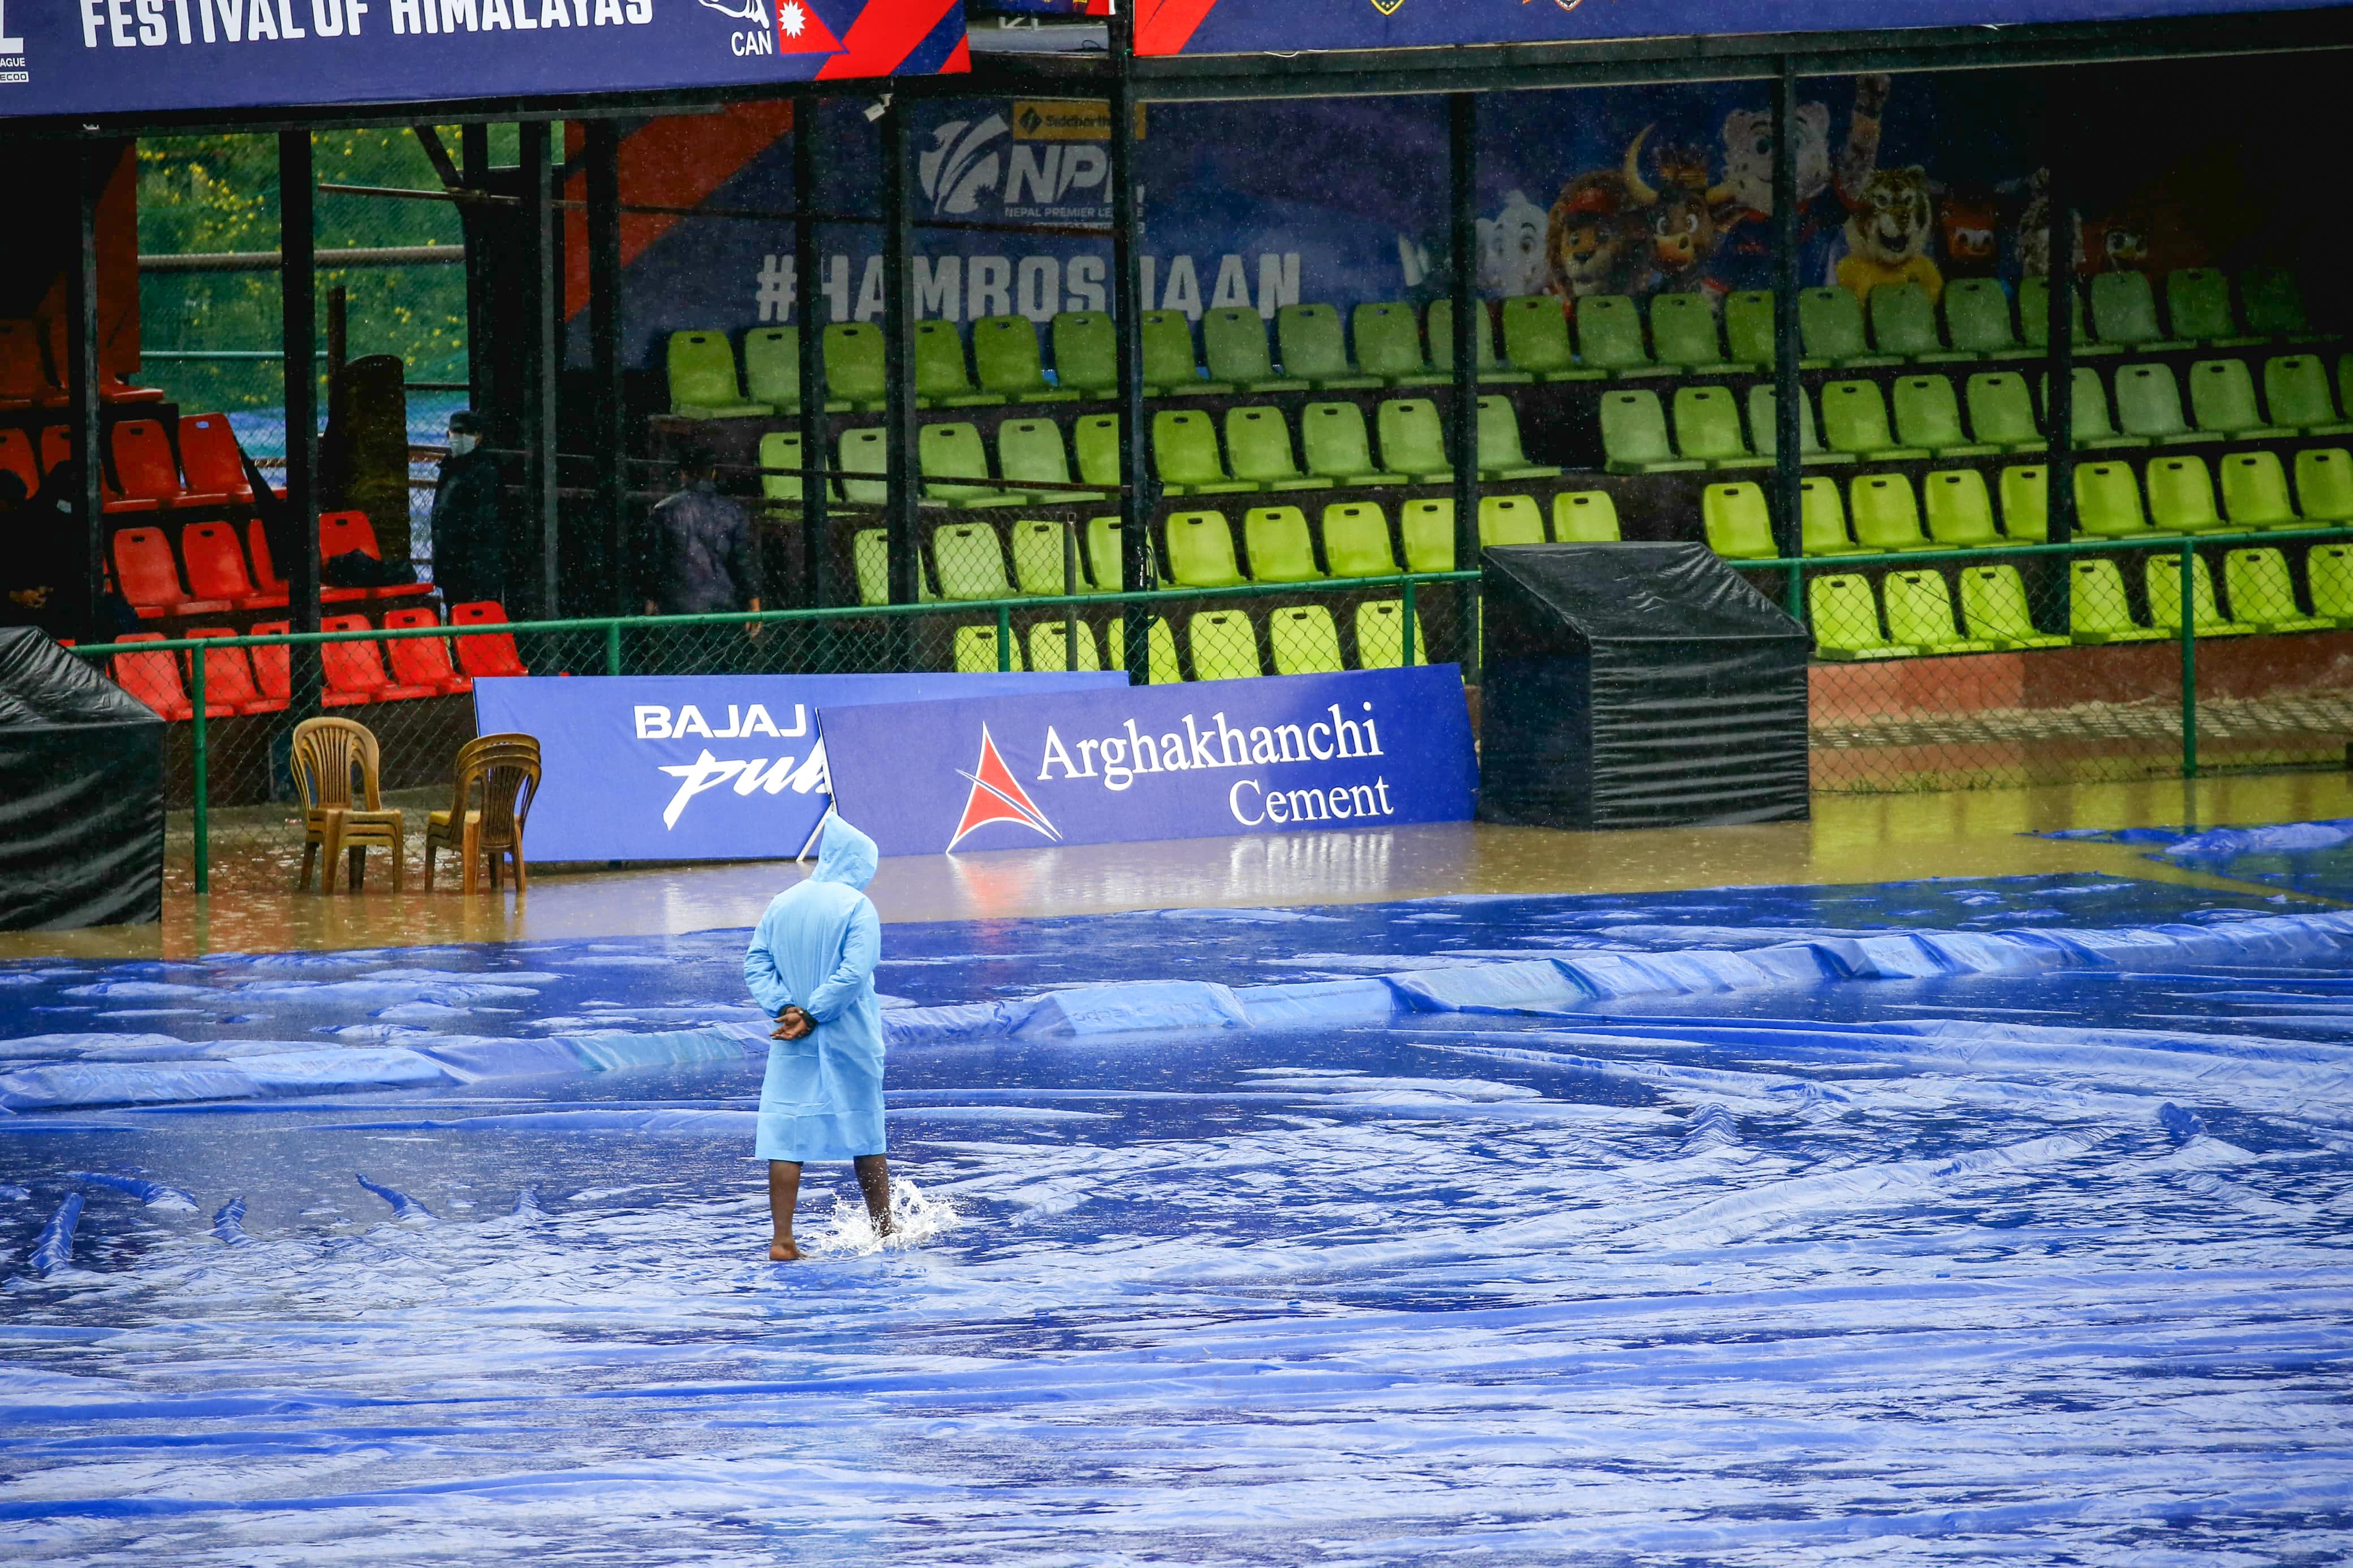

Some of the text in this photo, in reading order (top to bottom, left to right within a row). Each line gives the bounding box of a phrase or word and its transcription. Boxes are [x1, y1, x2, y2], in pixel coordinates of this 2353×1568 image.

[81, 0, 305, 47] FESTIVAL
[311, 0, 368, 37] OF
[731, 31, 772, 56] CAN
[1005, 207, 1041, 218] NEPAL
[1044, 207, 1095, 217] PREMIER
[634, 703, 807, 739] BAJAJ
[1037, 701, 1384, 791] Arghakhanchi
[1229, 775, 1394, 826] Cement
